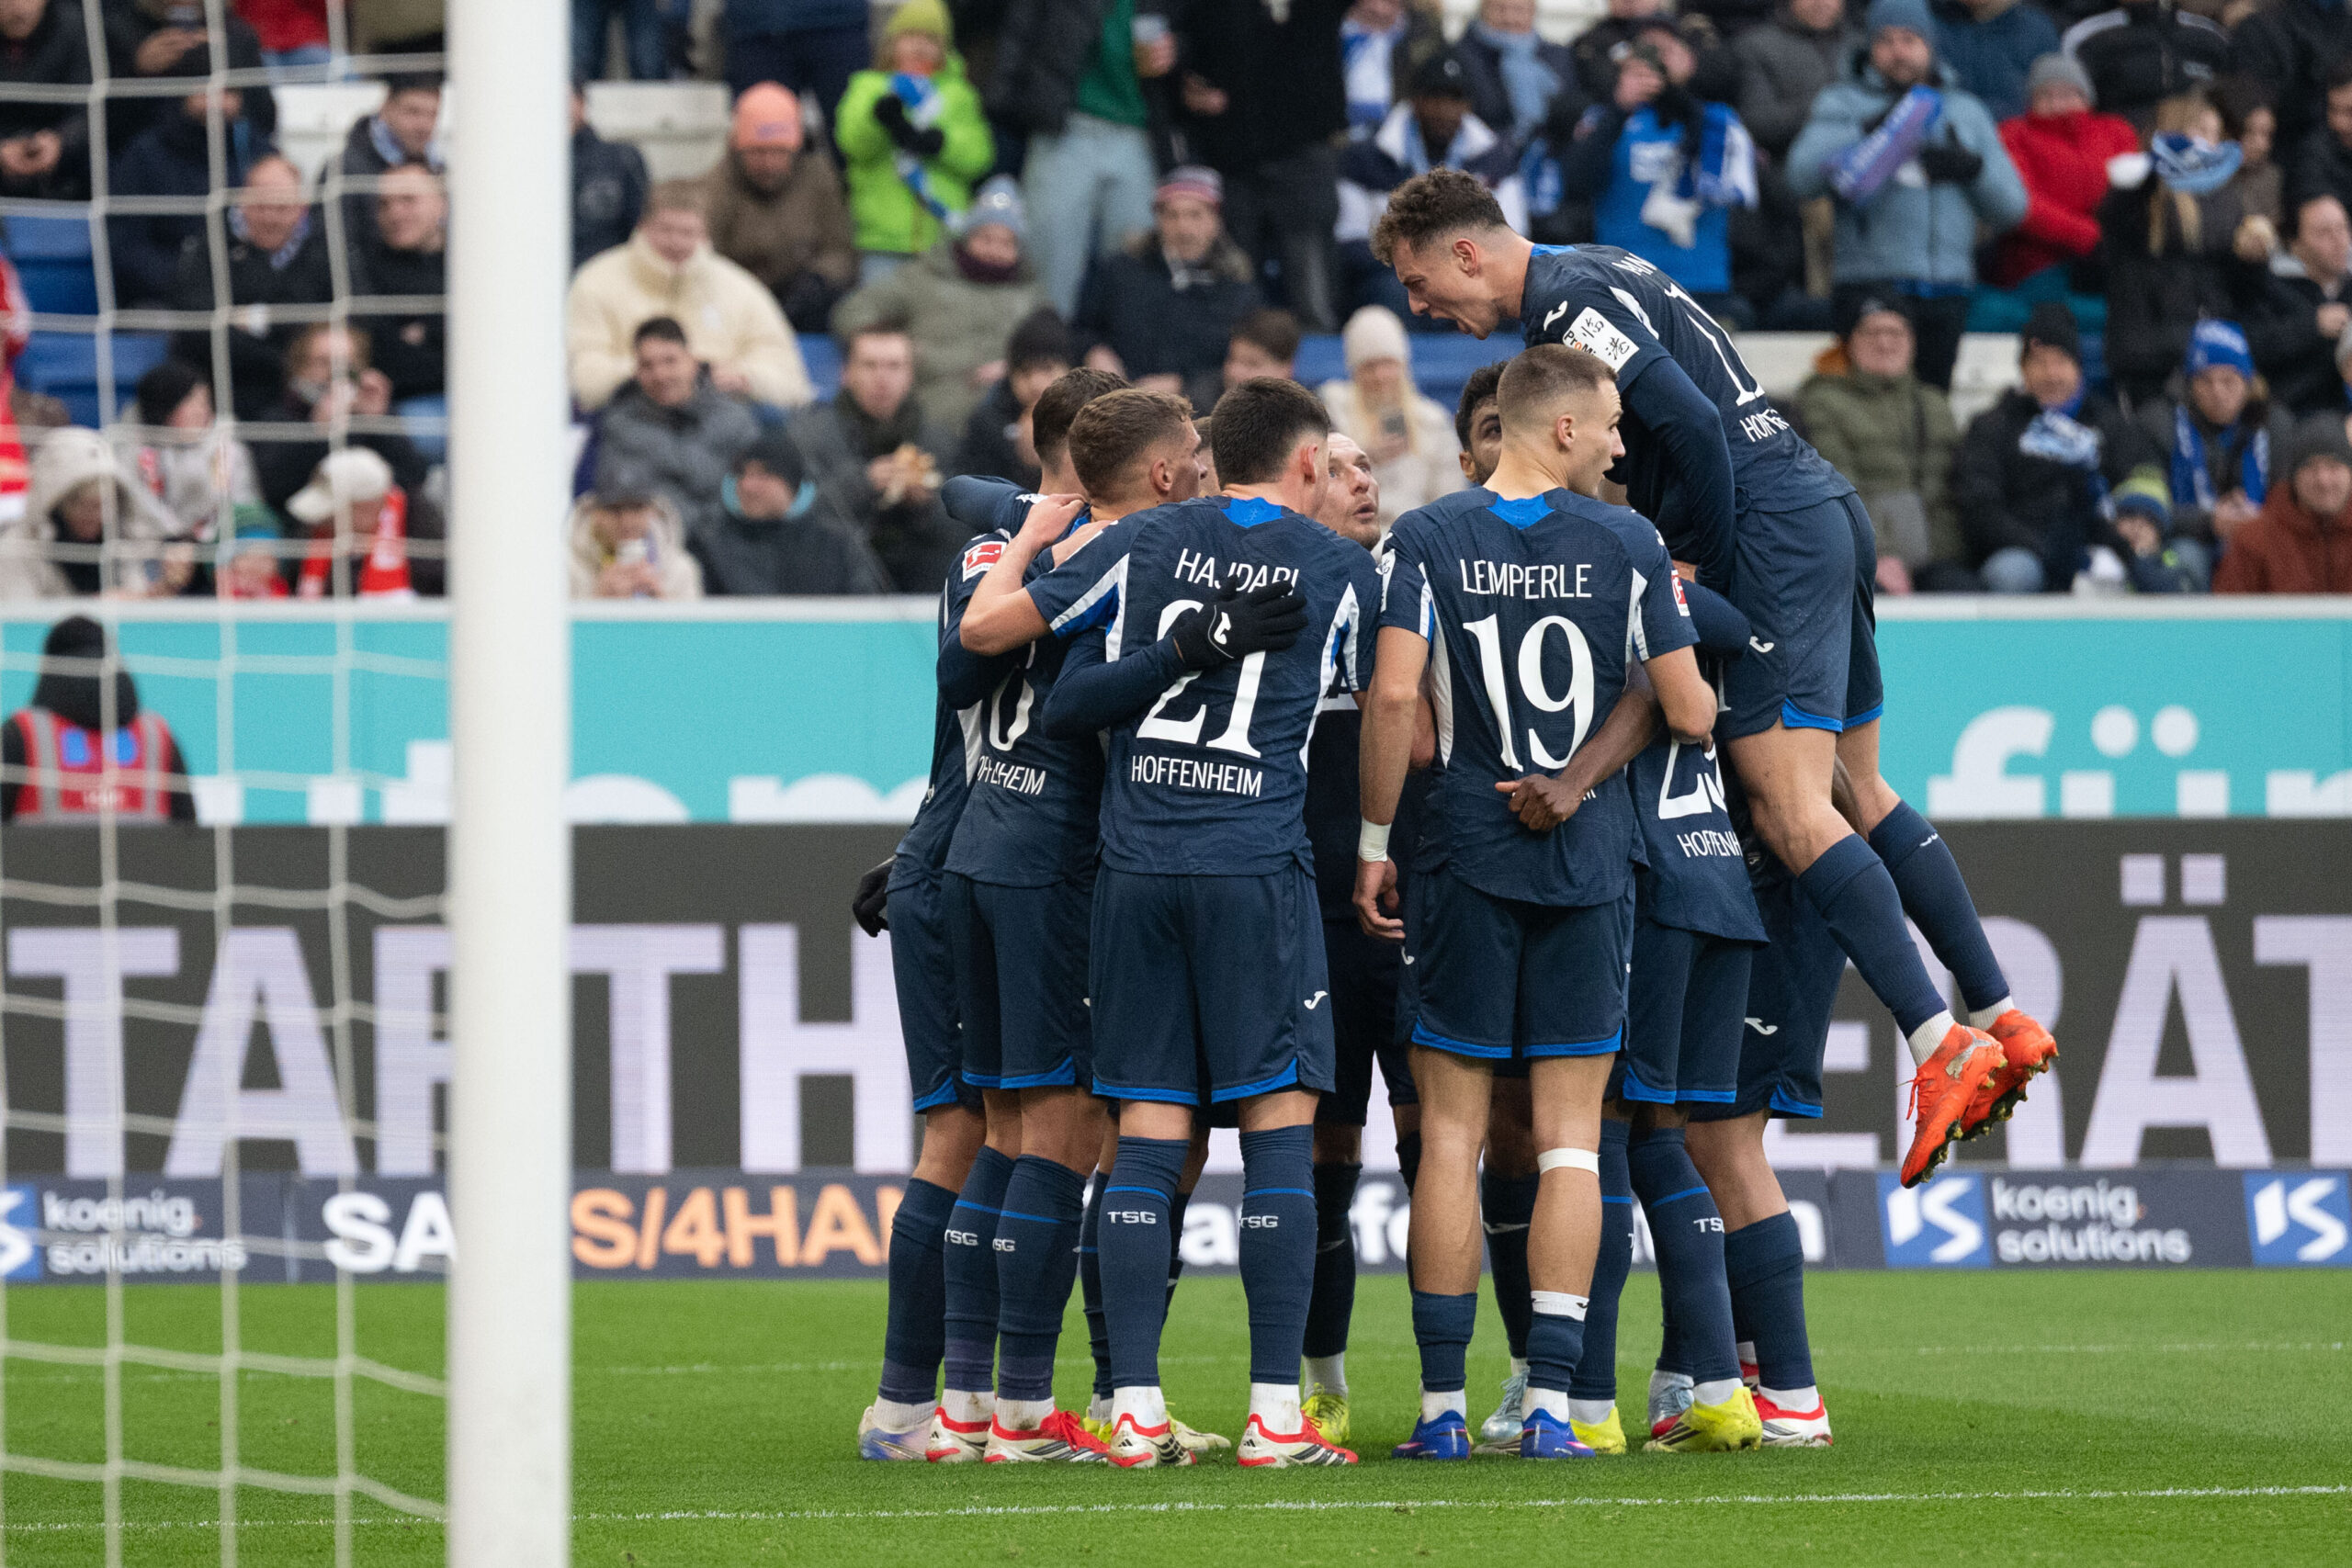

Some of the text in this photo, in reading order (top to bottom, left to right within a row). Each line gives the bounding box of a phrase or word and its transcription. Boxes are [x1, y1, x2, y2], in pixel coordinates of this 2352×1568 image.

[1460, 558, 1593, 600] LEMPERLE
[1463, 614, 1595, 773] 19
[1131, 754, 1263, 798] HOFFENHEIM
[43, 1188, 195, 1237] koenig
[1107, 1211, 1158, 1225] TSG
[1992, 1177, 2139, 1228] koenig
[1692, 1216, 1725, 1233] TS
[1996, 1223, 2192, 1264] solutions
[47, 1233, 247, 1275] solutions
